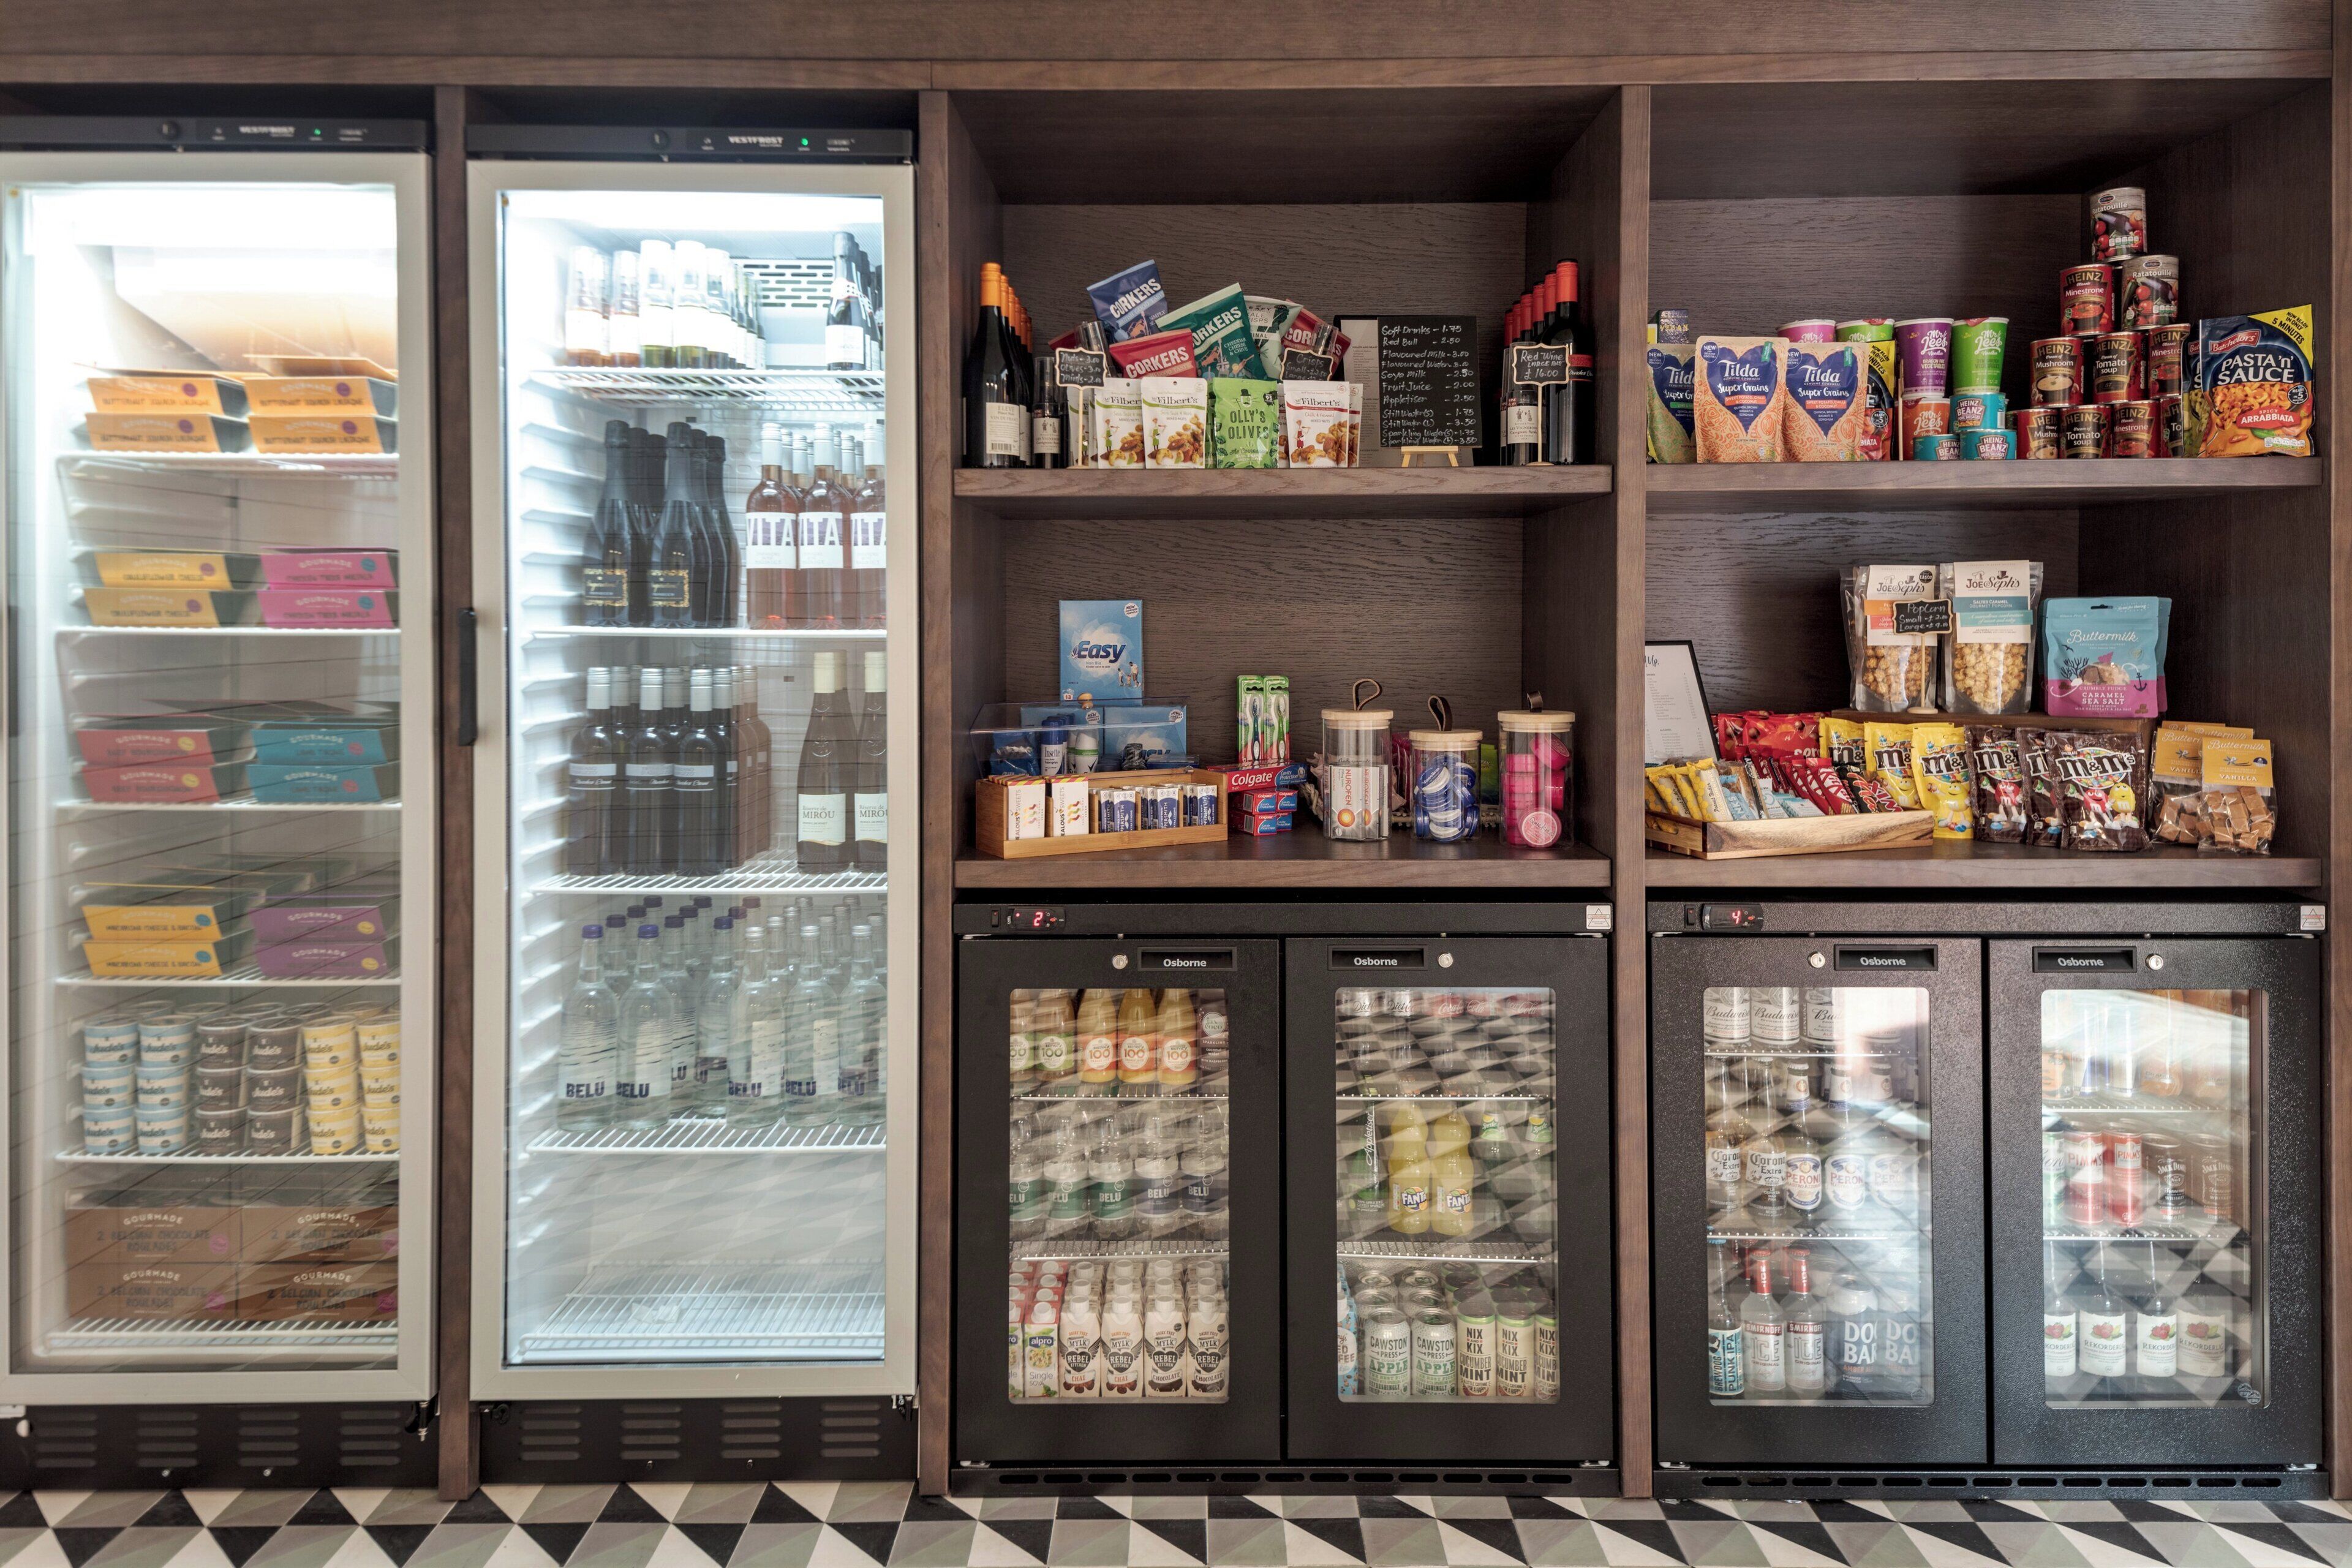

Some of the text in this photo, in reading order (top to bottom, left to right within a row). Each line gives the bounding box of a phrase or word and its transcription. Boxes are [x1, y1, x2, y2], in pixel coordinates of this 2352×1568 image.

[2092, 202, 2127, 214] Ratatouille
[2068, 271, 2101, 284] HEINZ
[2133, 270, 2171, 278] Ratatouille
[1110, 278, 1161, 318] CORKERS
[2065, 288, 2104, 297] Minestrone
[1382, 325, 1401, 337] Soft
[1403, 326, 1430, 334] Drinks
[2290, 319, 2304, 331] ONLY
[2277, 321, 2305, 345] MINUTES
[1224, 337, 1246, 348] CHEDDAR
[1383, 337, 1399, 347] Red
[2212, 334, 2256, 352] Batchelors
[1383, 350, 1427, 358] Flavoured
[1520, 350, 1564, 363] Red Wine
[2038, 345, 2073, 356] HEINZ
[1126, 347, 1189, 379] CORKERS
[1296, 354, 1324, 368] Crisps
[1382, 360, 1426, 369] Flavoured
[1427, 360, 1450, 369] Water
[2036, 360, 2073, 369] Mushroom
[2095, 358, 2127, 369] Tomato
[2221, 353, 2275, 371] PASTA
[1286, 362, 1306, 373] Small
[1717, 360, 1760, 377] Tilda
[1381, 371, 1404, 380] Soya
[1407, 369, 1426, 378] Milk
[1799, 365, 1841, 383] Tilda
[2217, 367, 2295, 385] SAUCE
[1382, 382, 1406, 393] Fruit
[1406, 382, 1433, 391] Juice
[1717, 382, 1769, 395] Super Grains
[1797, 387, 1850, 399] Super Grains
[1157, 396, 1199, 405] Filbert's
[1302, 398, 1340, 407] Filbert's
[1384, 394, 1428, 408] Appletiser
[1230, 409, 1266, 423] OLLY'S
[1957, 405, 1983, 415] BEANZ
[1402, 419, 1422, 428] Water
[2241, 413, 2294, 424] ARRABBIATA
[1228, 426, 1269, 440] OLIVES
[2066, 431, 2100, 440] Tomato
[1382, 437, 1419, 447] Sparkling
[1979, 442, 2007, 452] BEANZ
[746, 514, 793, 546] VITA
[1966, 576, 2020, 592] JOE Seph's
[1899, 614, 1922, 624] Small
[1899, 622, 1926, 632] Large
[2067, 629, 2139, 644] Buttermilk
[1077, 640, 1126, 663] Easy
[2207, 739, 2266, 751] Buttermilk
[1045, 747, 1060, 758] Insette
[1231, 772, 1272, 786] Colgate
[1421, 767, 1441, 785] Vaseline
[802, 810, 836, 820] MIROU
[1033, 911, 1042, 927] 2
[1732, 910, 1741, 924] 4
[1163, 957, 1207, 968] Osborne
[1354, 956, 1398, 967] Osborne
[1860, 954, 1906, 968] Osborne
[2057, 956, 2105, 969] Osborne
[1123, 1048, 1146, 1059] 100
[1166, 1050, 1189, 1061] 100
[253, 1086, 285, 1098] Jude's
[565, 1081, 605, 1099] BELU
[1363, 1111, 1375, 1166] Appletiser
[1760, 1165, 1782, 1174] Extra
[1099, 1192, 1121, 1203] BELU
[1148, 1188, 1169, 1199] BELU
[123, 1212, 185, 1226] GOURMADE
[122, 1269, 181, 1283] GOURMADE
[1466, 1327, 1483, 1339] NIX
[1502, 1329, 1518, 1341] NIX
[1746, 1324, 1782, 1335] SMIRNOFF
[1370, 1336, 1408, 1352] CAWSTON
[1417, 1336, 1454, 1352] CAWSTON
[1467, 1343, 1483, 1354] KIX
[1502, 1344, 1518, 1356] KIX
[1067, 1355, 1089, 1363] REBEL
[1110, 1355, 1132, 1364] REBEL
[1370, 1360, 1408, 1373] APPLE
[1416, 1360, 1455, 1374] APPLE
[1153, 1373, 1180, 1381] CHOCOLATE
[1196, 1373, 1223, 1382] CHOCOLATE
[1460, 1368, 1491, 1381] MINT
